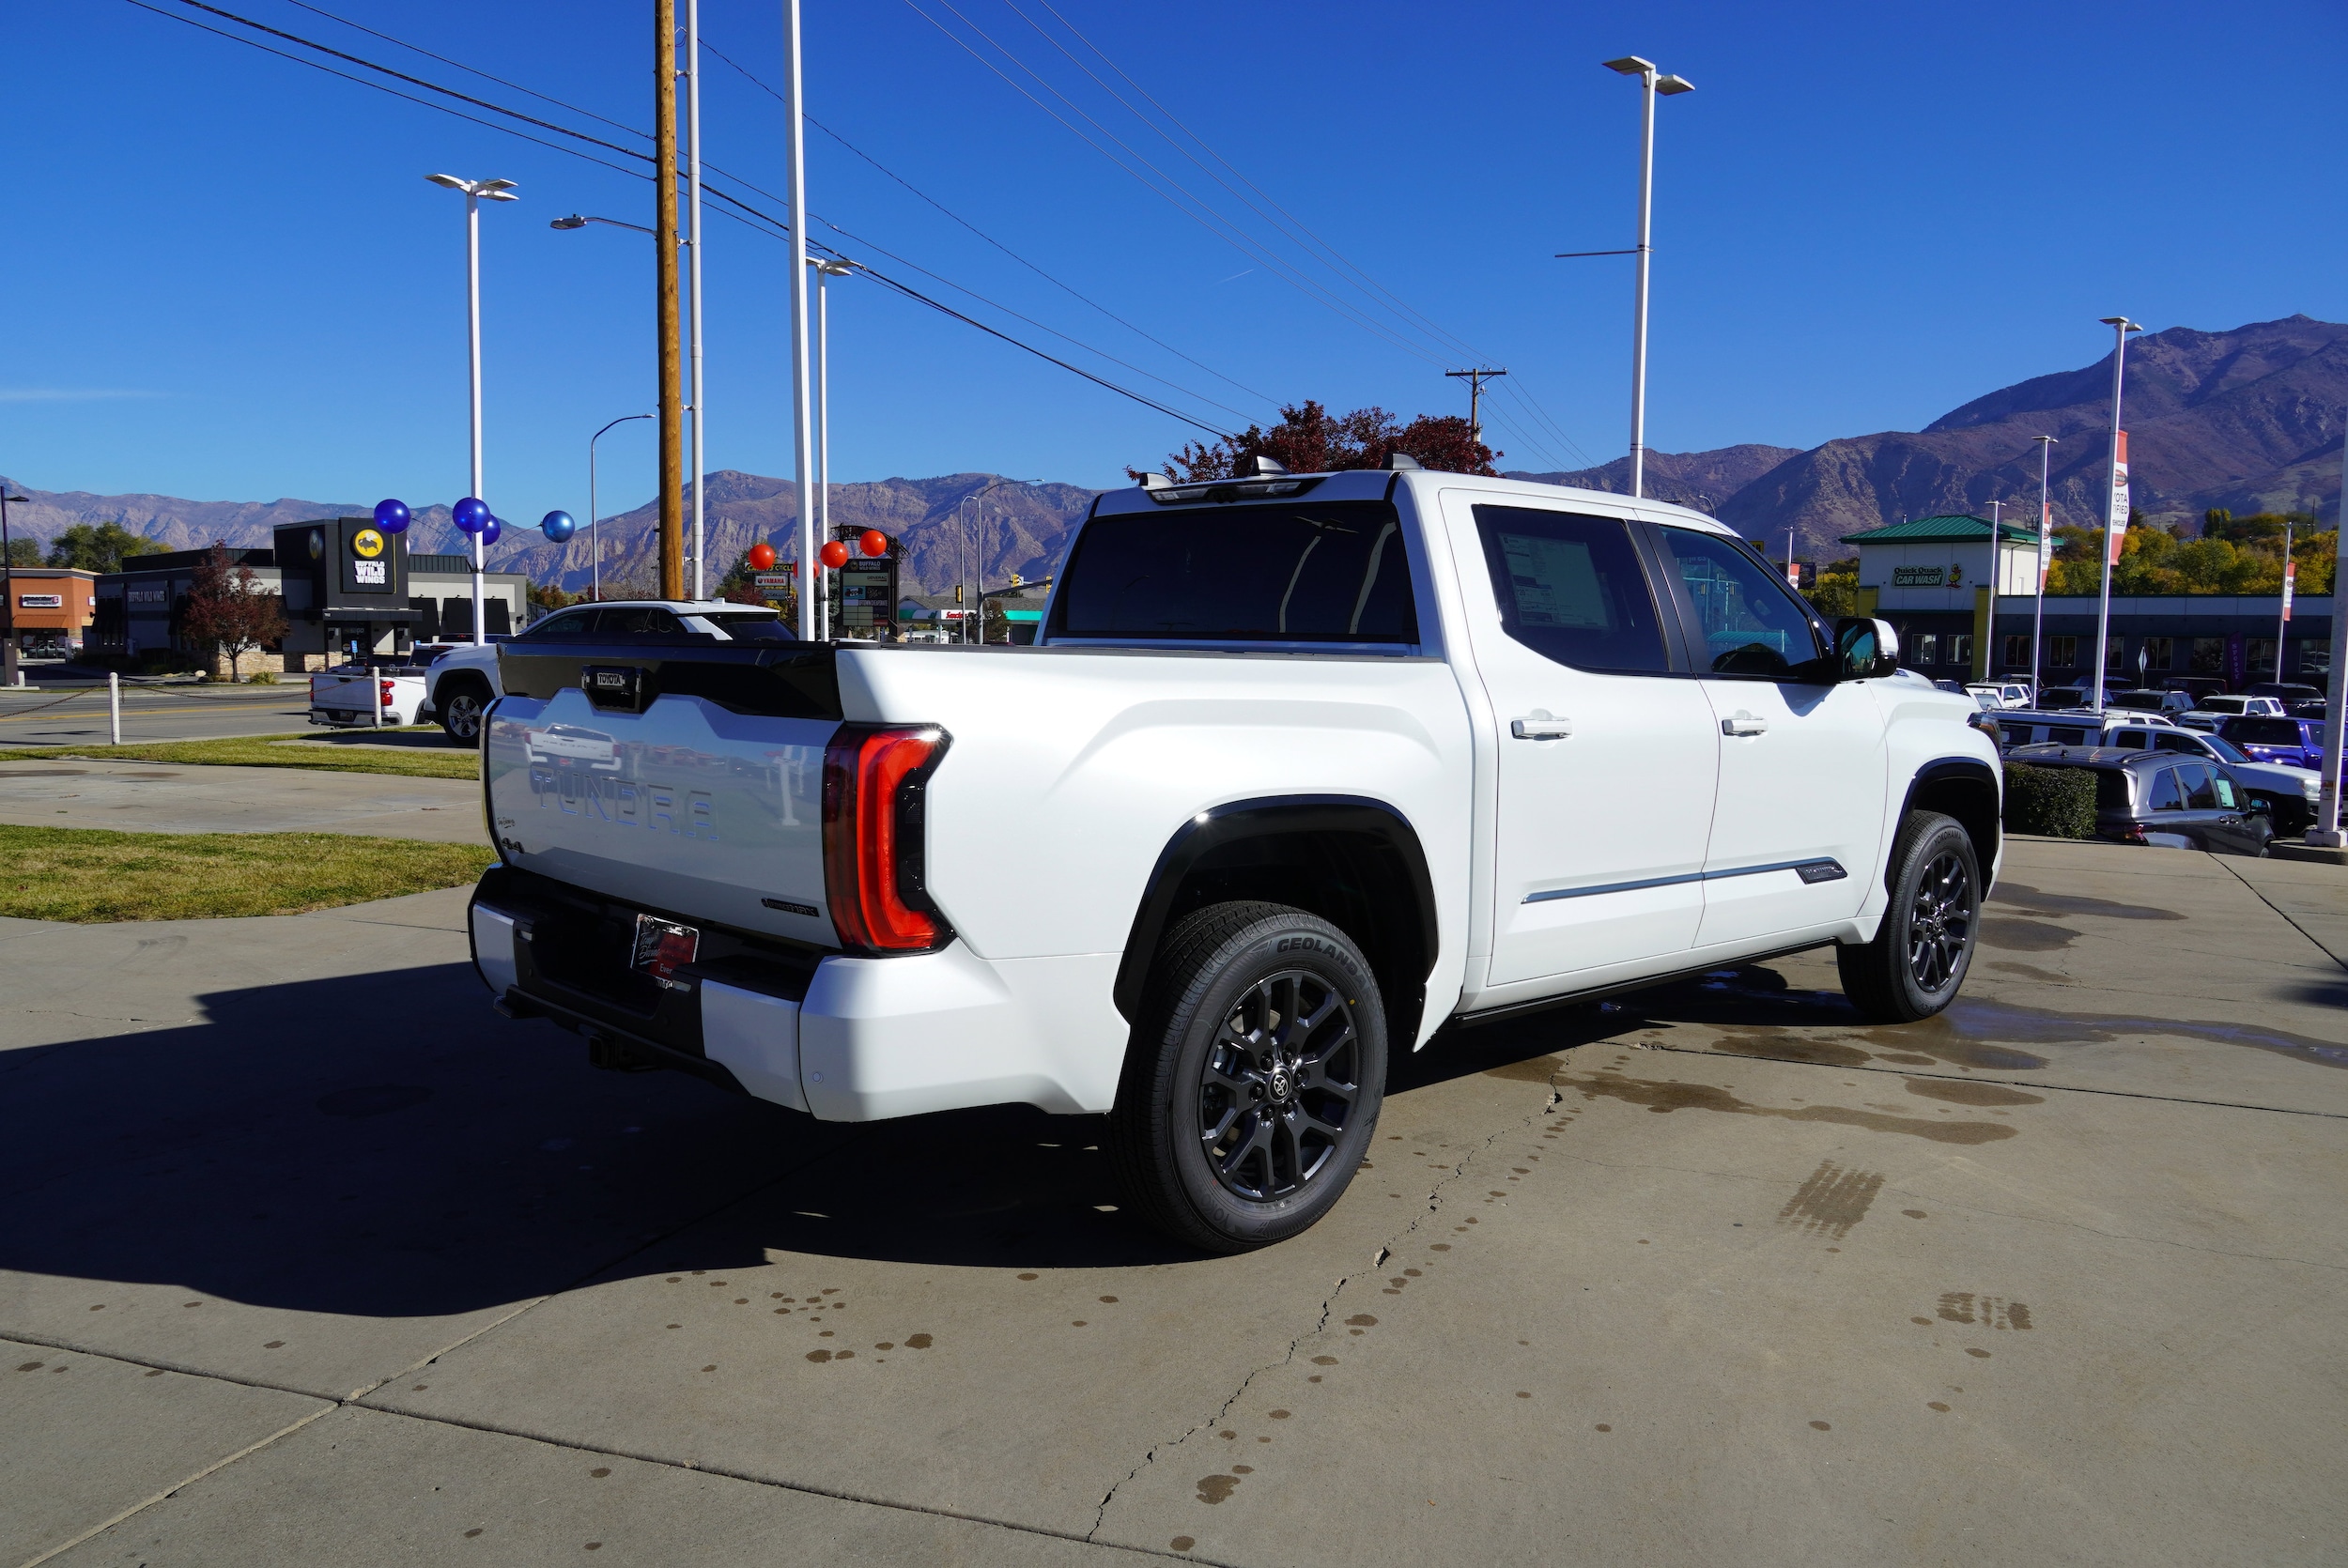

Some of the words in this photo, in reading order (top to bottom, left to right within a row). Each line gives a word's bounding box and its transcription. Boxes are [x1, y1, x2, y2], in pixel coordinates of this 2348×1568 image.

[355, 566, 386, 576] WILD
[1918, 566, 1943, 575] Quack
[355, 575, 386, 584] WINGS
[1896, 576, 1915, 585] CAR
[1915, 575, 1942, 585] WASH
[598, 673, 622, 684] TOYOTA
[531, 765, 719, 841] TUNDRA
[1934, 829, 1962, 846] YOKOHAMA
